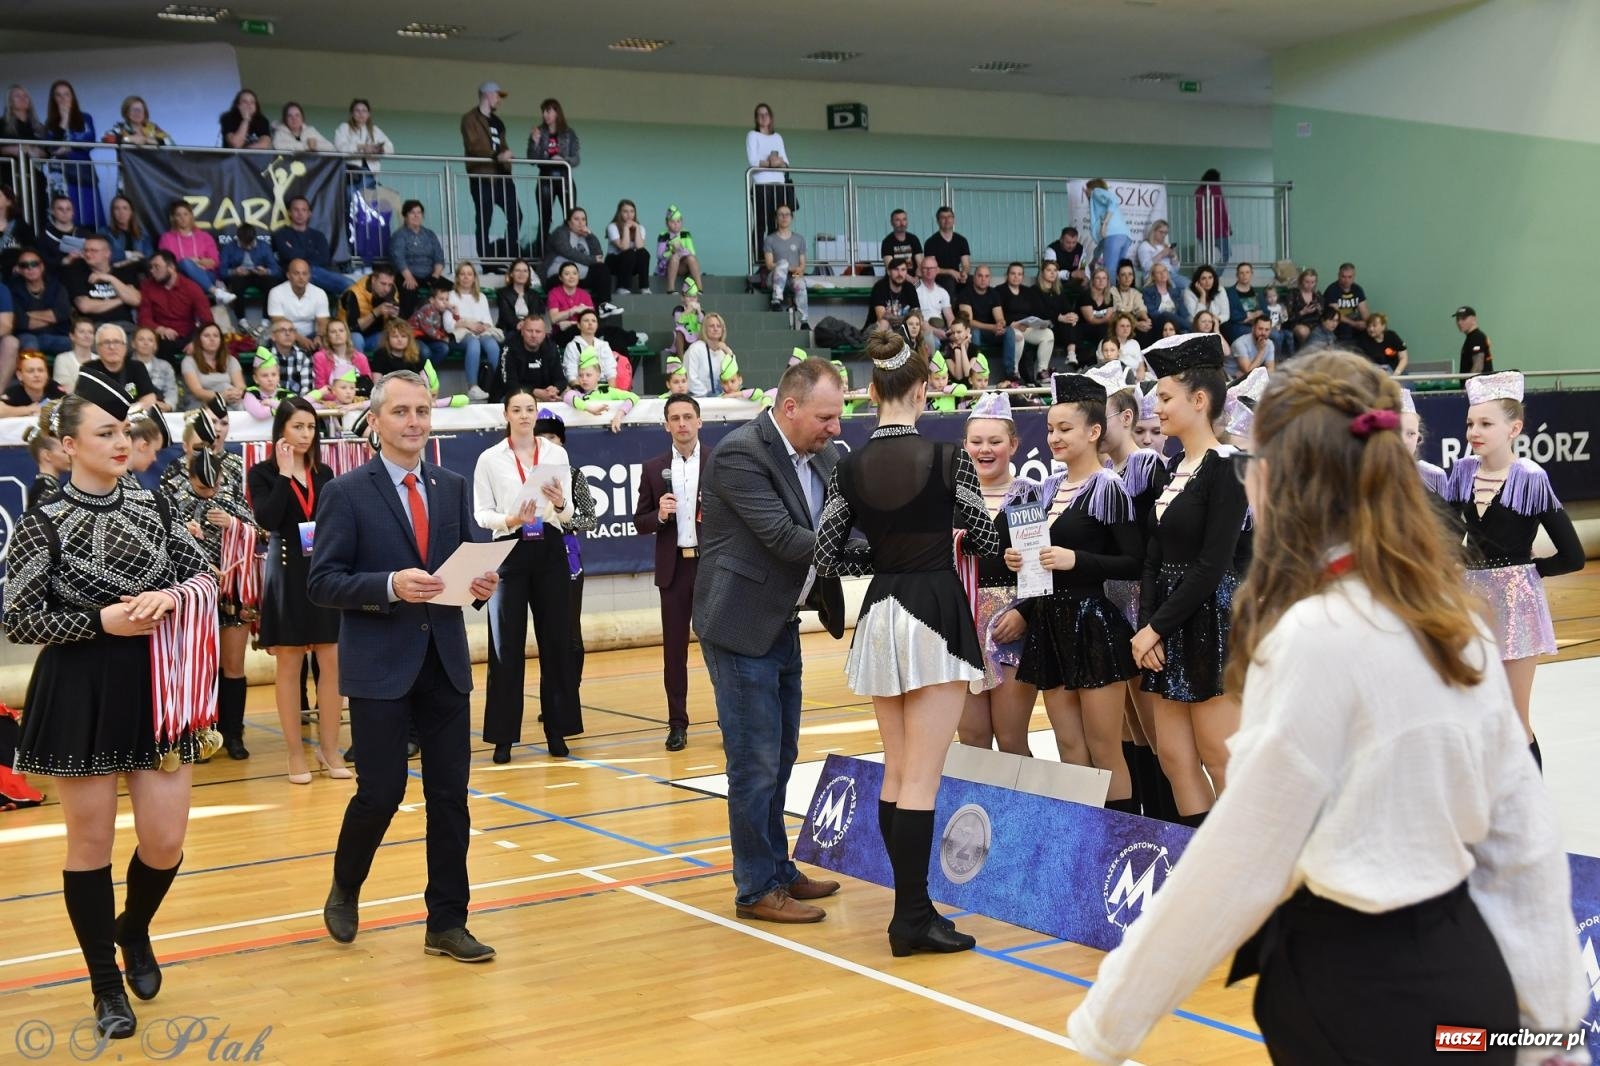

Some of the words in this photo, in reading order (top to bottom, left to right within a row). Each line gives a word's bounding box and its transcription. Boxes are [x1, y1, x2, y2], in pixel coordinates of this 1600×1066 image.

[834, 111, 855, 127] D
[183, 195, 292, 232] ZARA
[1010, 506, 1045, 526] DYPLOM
[586, 522, 638, 539] RACIB
[1120, 842, 1158, 858] SPORTOWY
[1576, 915, 1600, 935] SPOR
